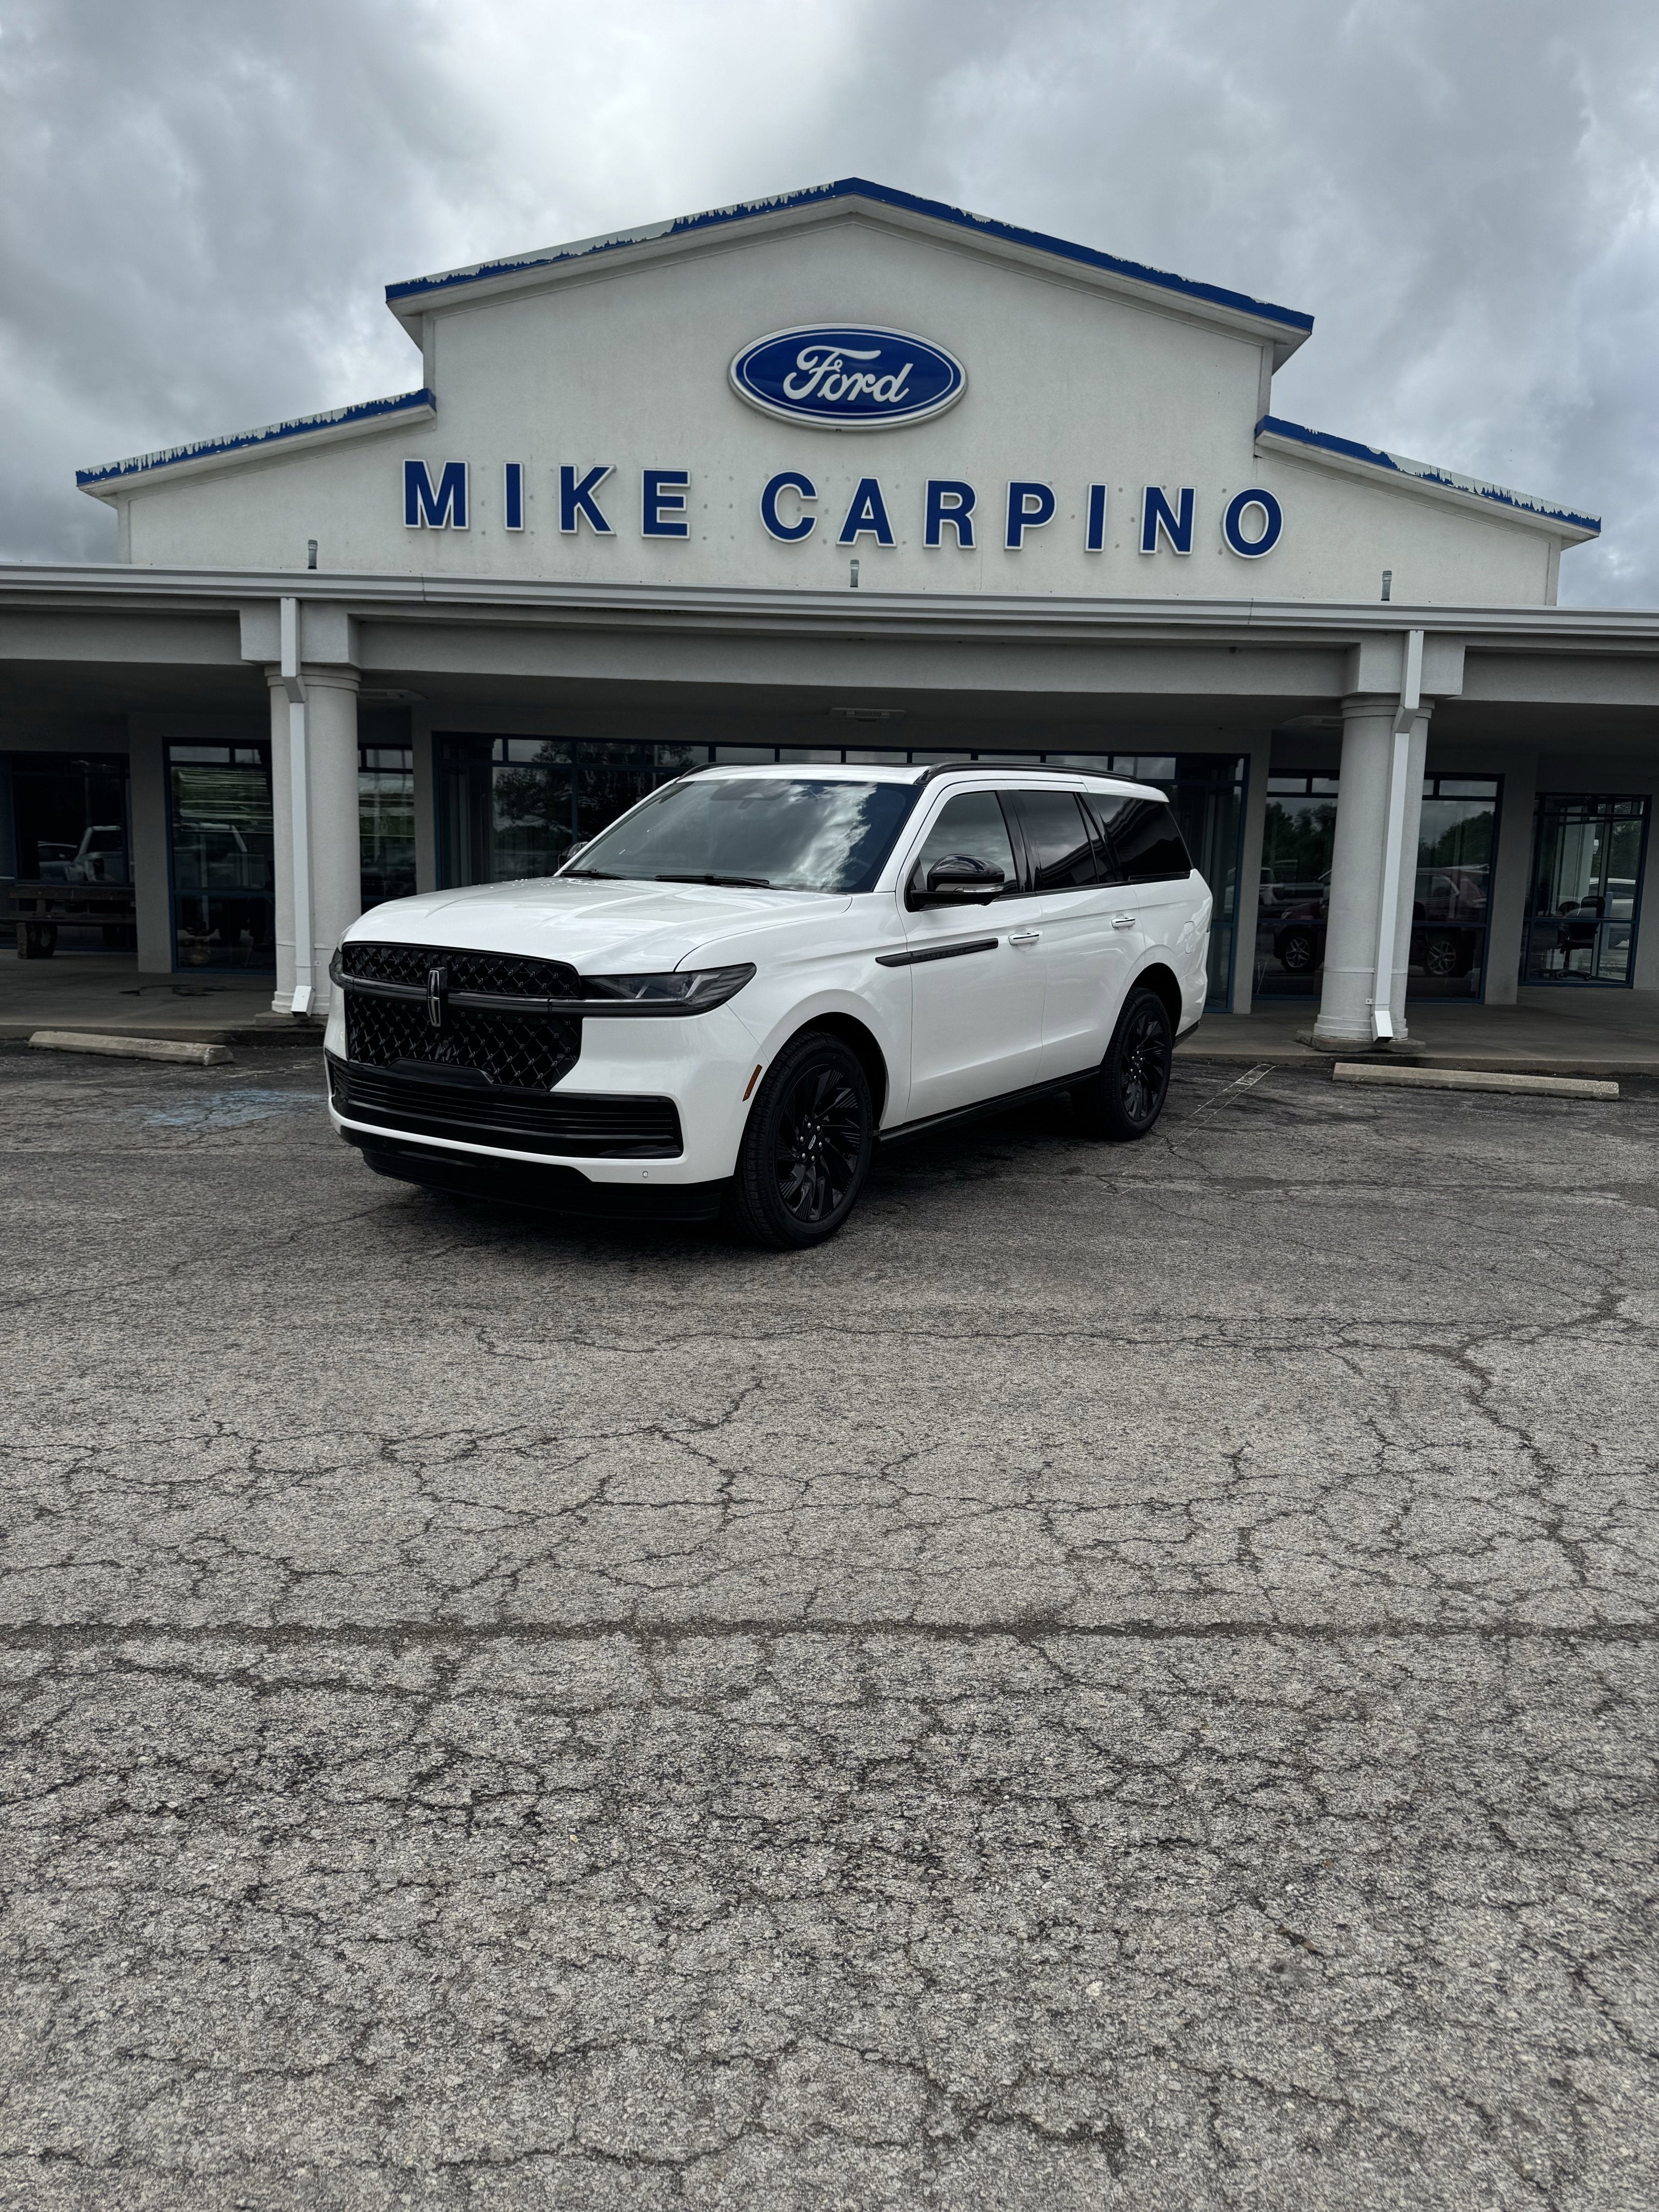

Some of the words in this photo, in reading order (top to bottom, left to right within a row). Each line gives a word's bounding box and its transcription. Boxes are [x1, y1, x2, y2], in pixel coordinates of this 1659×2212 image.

[783, 346, 913, 402] Ford
[403, 459, 691, 539] MIKE
[759, 470, 1284, 559] CARPINO
